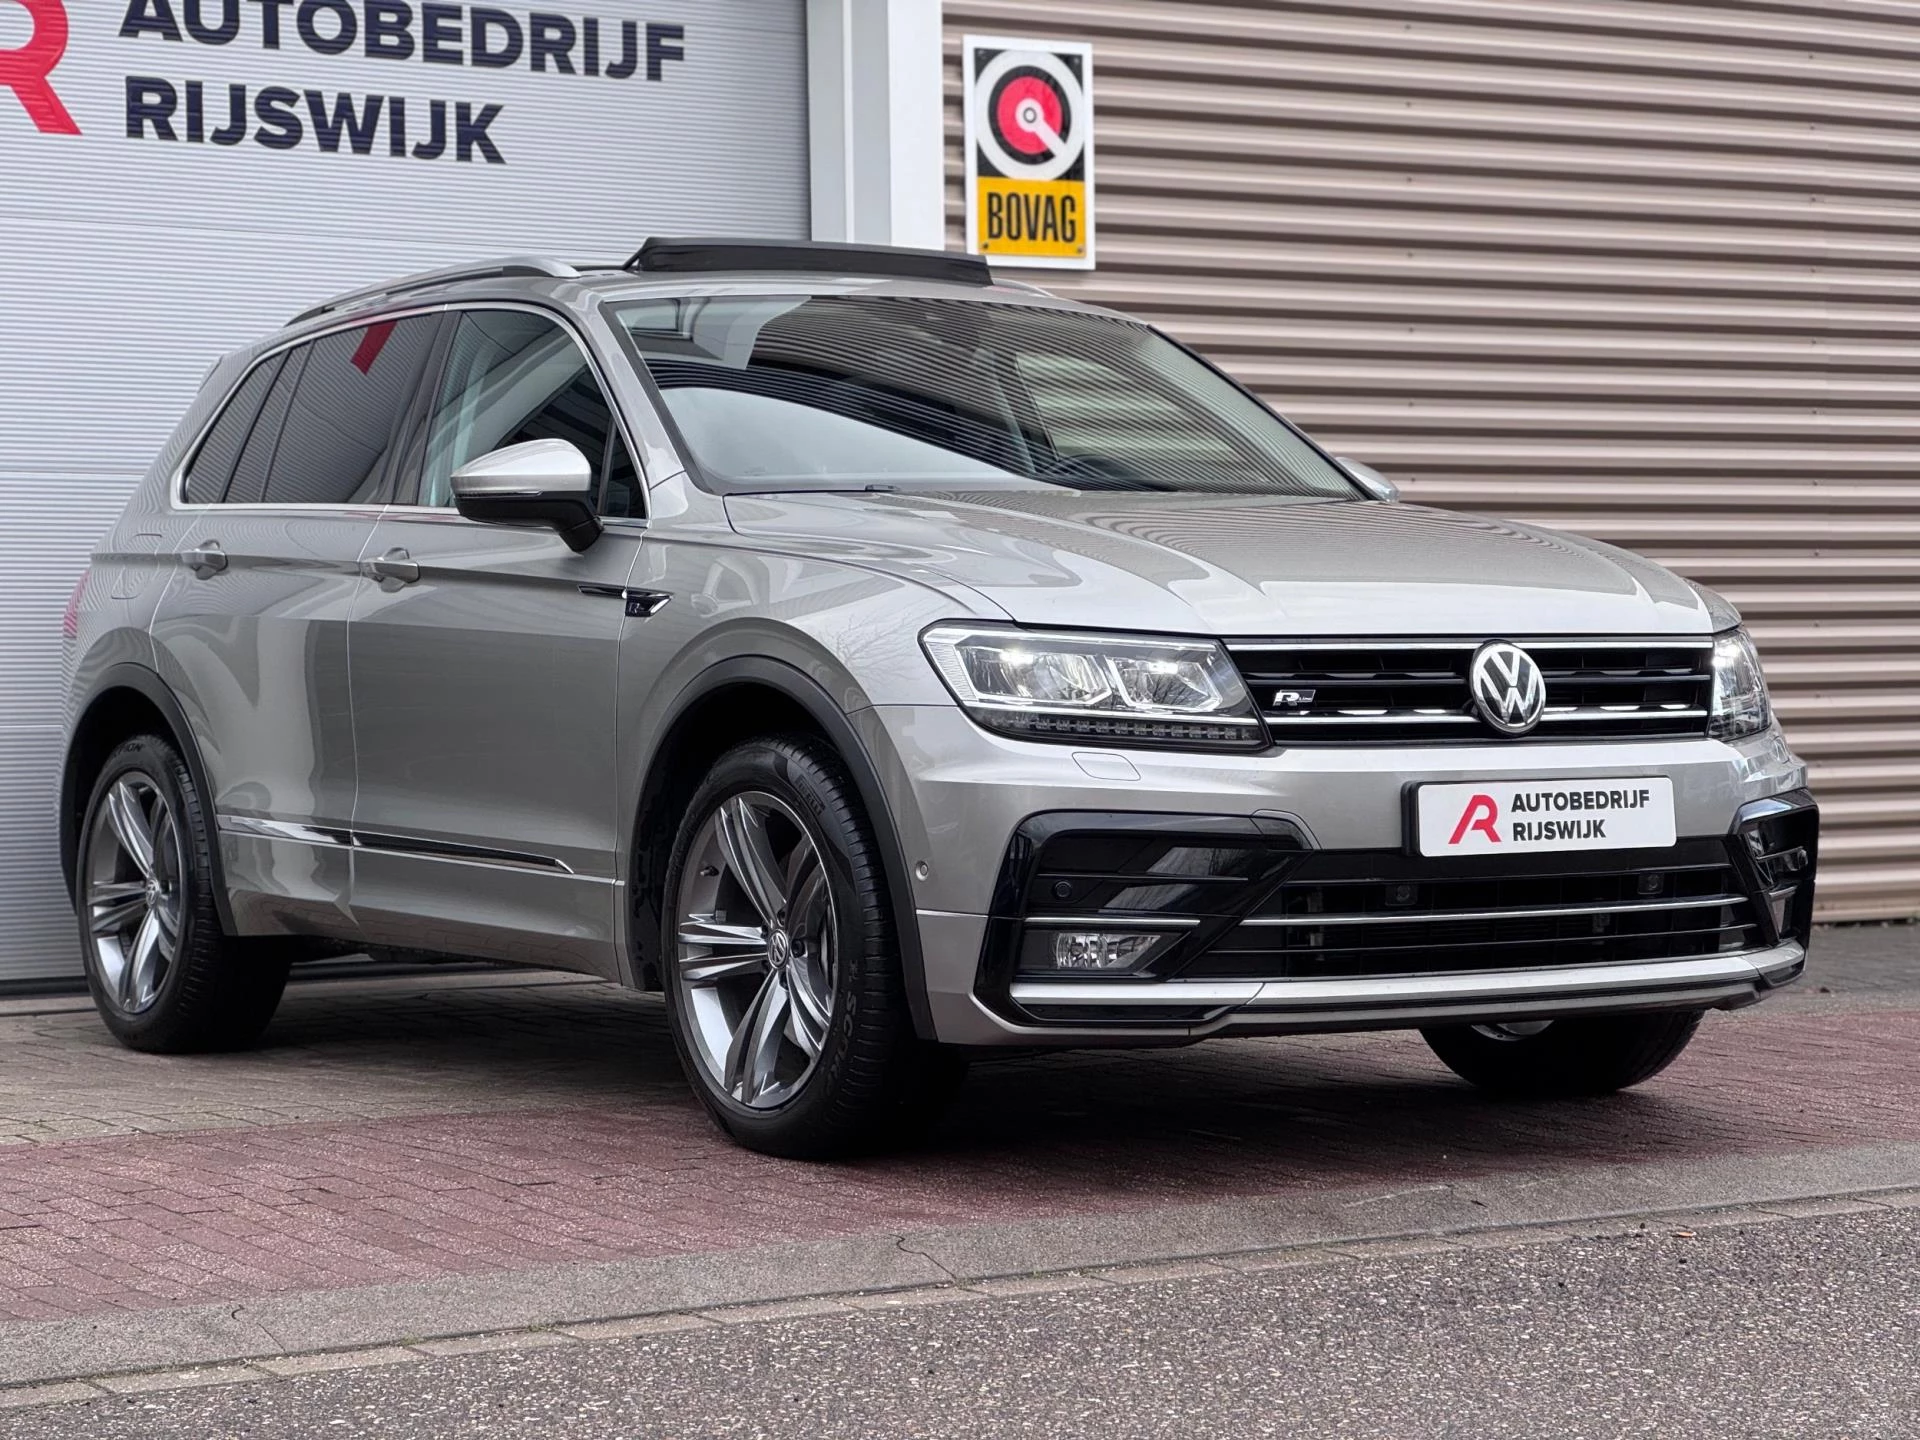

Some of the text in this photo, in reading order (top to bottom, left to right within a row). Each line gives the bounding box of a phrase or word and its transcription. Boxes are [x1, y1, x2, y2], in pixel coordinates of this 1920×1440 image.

[118, 0, 685, 81] AUTOBEDRIJF
[125, 75, 507, 164] RIJSWIJK
[987, 191, 1076, 243] BOVAG
[1511, 789, 1650, 813] AUTOBEDRIJF
[1512, 819, 1607, 842] RIJSWIJK
